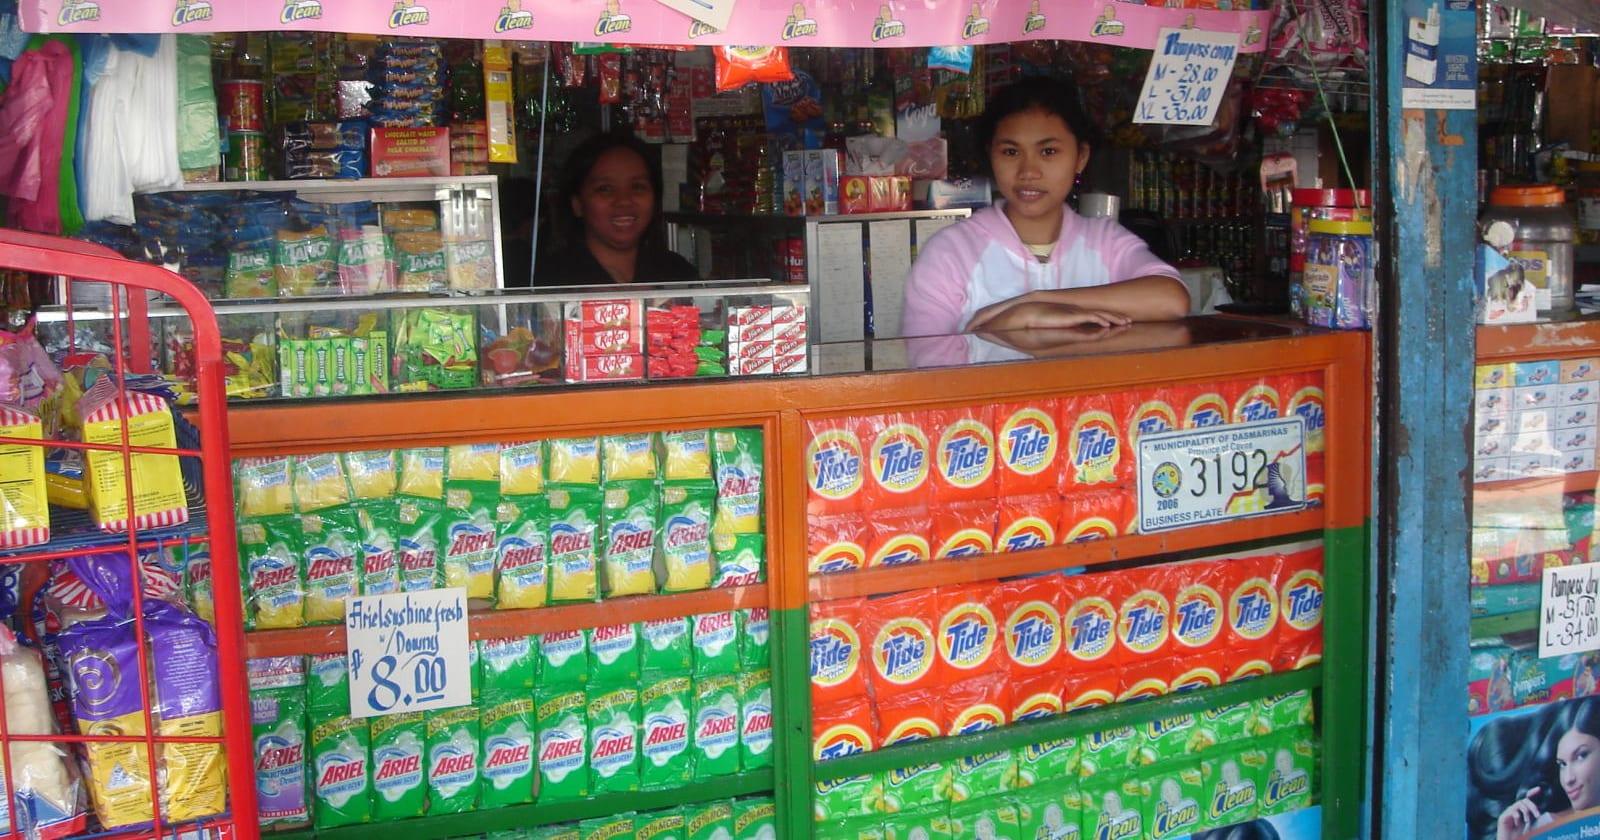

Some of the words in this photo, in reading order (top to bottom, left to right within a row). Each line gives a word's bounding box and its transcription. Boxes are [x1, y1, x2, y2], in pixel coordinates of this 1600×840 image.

[58, 6, 97, 26] Clean
[172, 6, 210, 26] Clean
[280, 4, 321, 24] Clean
[389, 9, 428, 28] Clean
[494, 15, 533, 33] Clean
[595, 18, 631, 37] Clean
[782, 23, 816, 41] Clean
[872, 23, 904, 41] Clean
[1178, 63, 1218, 84] 28.00
[1149, 85, 1157, 98] L
[1171, 85, 1212, 102] 31.00
[904, 102, 936, 126] Goya
[1142, 101, 1155, 120] XL
[286, 243, 328, 261] TANG
[1008, 425, 1050, 464] Tide
[1077, 426, 1116, 466] Tide
[1154, 436, 1216, 450] MUNICIPALITY
[1218, 434, 1229, 442] OF
[1222, 444, 1230, 452] of
[814, 448, 860, 489] Tide
[881, 442, 924, 482] Tide
[946, 438, 989, 477] Tide
[1190, 448, 1268, 497] 3192
[1146, 512, 1192, 526] BUSINESS
[1194, 508, 1223, 520] PLATE
[449, 532, 496, 556] ARIEL
[553, 532, 591, 552] ARIEL
[609, 530, 654, 554] ARIEL
[307, 556, 355, 580] ARIEL
[500, 545, 544, 570] ARIEL
[254, 566, 296, 590] ARIEL
[434, 597, 462, 632] fresh
[1236, 593, 1272, 628] Tide
[1289, 585, 1323, 621] Tide
[697, 612, 732, 636] ARIEL
[748, 608, 768, 624] ARI
[1127, 608, 1164, 643] Tide
[1178, 600, 1216, 636] Tide
[1546, 607, 1554, 624] M
[594, 624, 632, 642] ARIEL
[948, 621, 989, 660] Tide
[1014, 618, 1054, 658] Tide
[1072, 612, 1110, 650] Tide
[1546, 630, 1554, 646] L
[810, 636, 852, 676] Tide
[882, 636, 926, 676] Tide
[368, 656, 446, 712] 8.00
[646, 724, 686, 745] ARIEL
[700, 715, 736, 737] ARIEL
[744, 715, 772, 734] ARI
[258, 744, 303, 770] ARIEL
[487, 746, 530, 768] ARIEL
[541, 738, 582, 761] ARIEL
[593, 734, 632, 758] ARIEL
[320, 760, 364, 788] ARIEL
[376, 754, 420, 780] ARIEL
[432, 752, 475, 778] ARIEL
[1210, 786, 1253, 818] Clean
[1264, 776, 1305, 808] Clean
[610, 822, 632, 835] MORE
[659, 816, 684, 830] MORE
[1153, 805, 1196, 840] Clean
